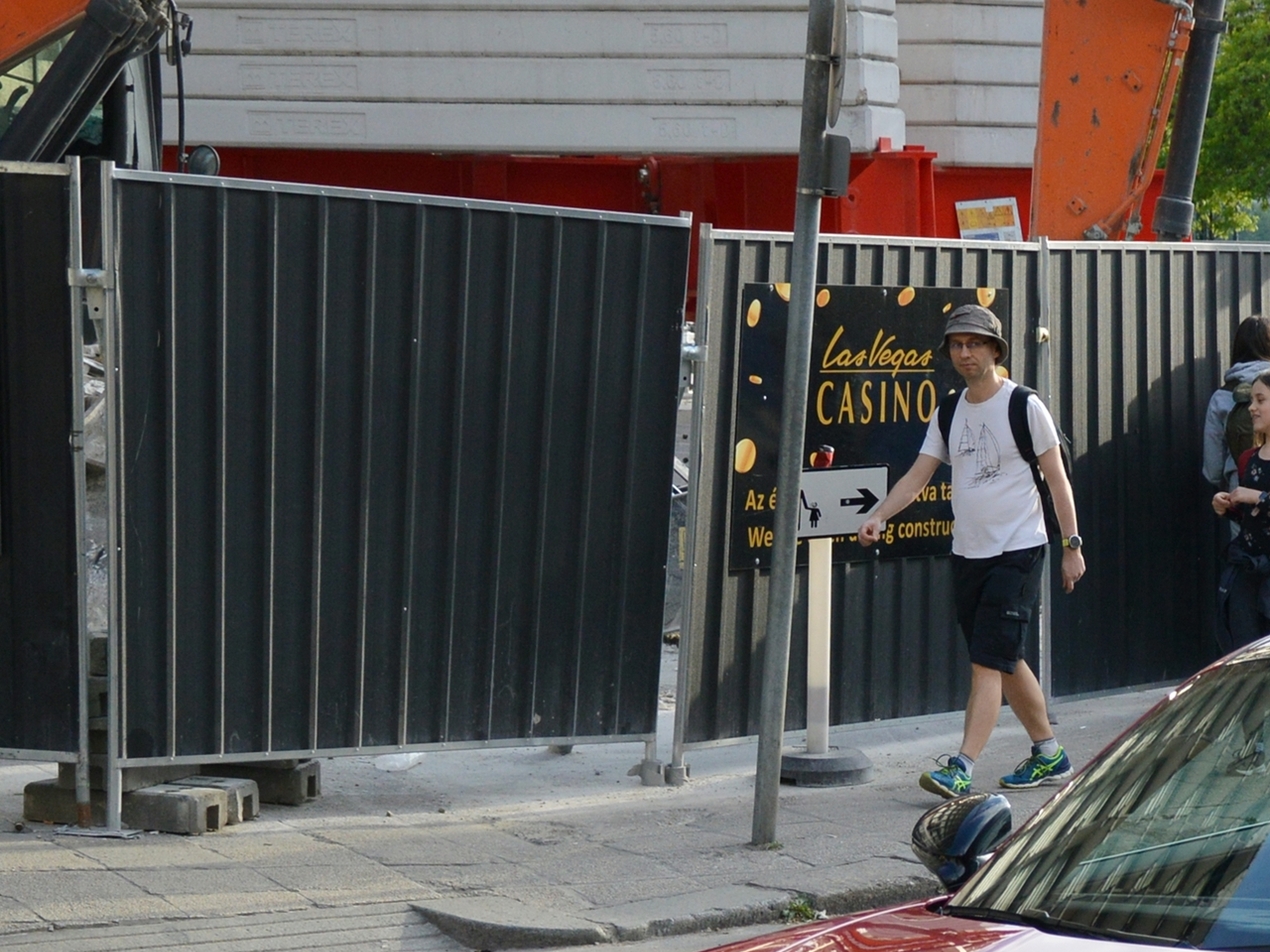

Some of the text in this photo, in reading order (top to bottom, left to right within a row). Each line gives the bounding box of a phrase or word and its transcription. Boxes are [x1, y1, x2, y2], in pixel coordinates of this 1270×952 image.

[816, 379, 937, 425] CASINO
[745, 489, 765, 511] Az
[748, 526, 774, 548] We
[898, 518, 955, 539] construc
